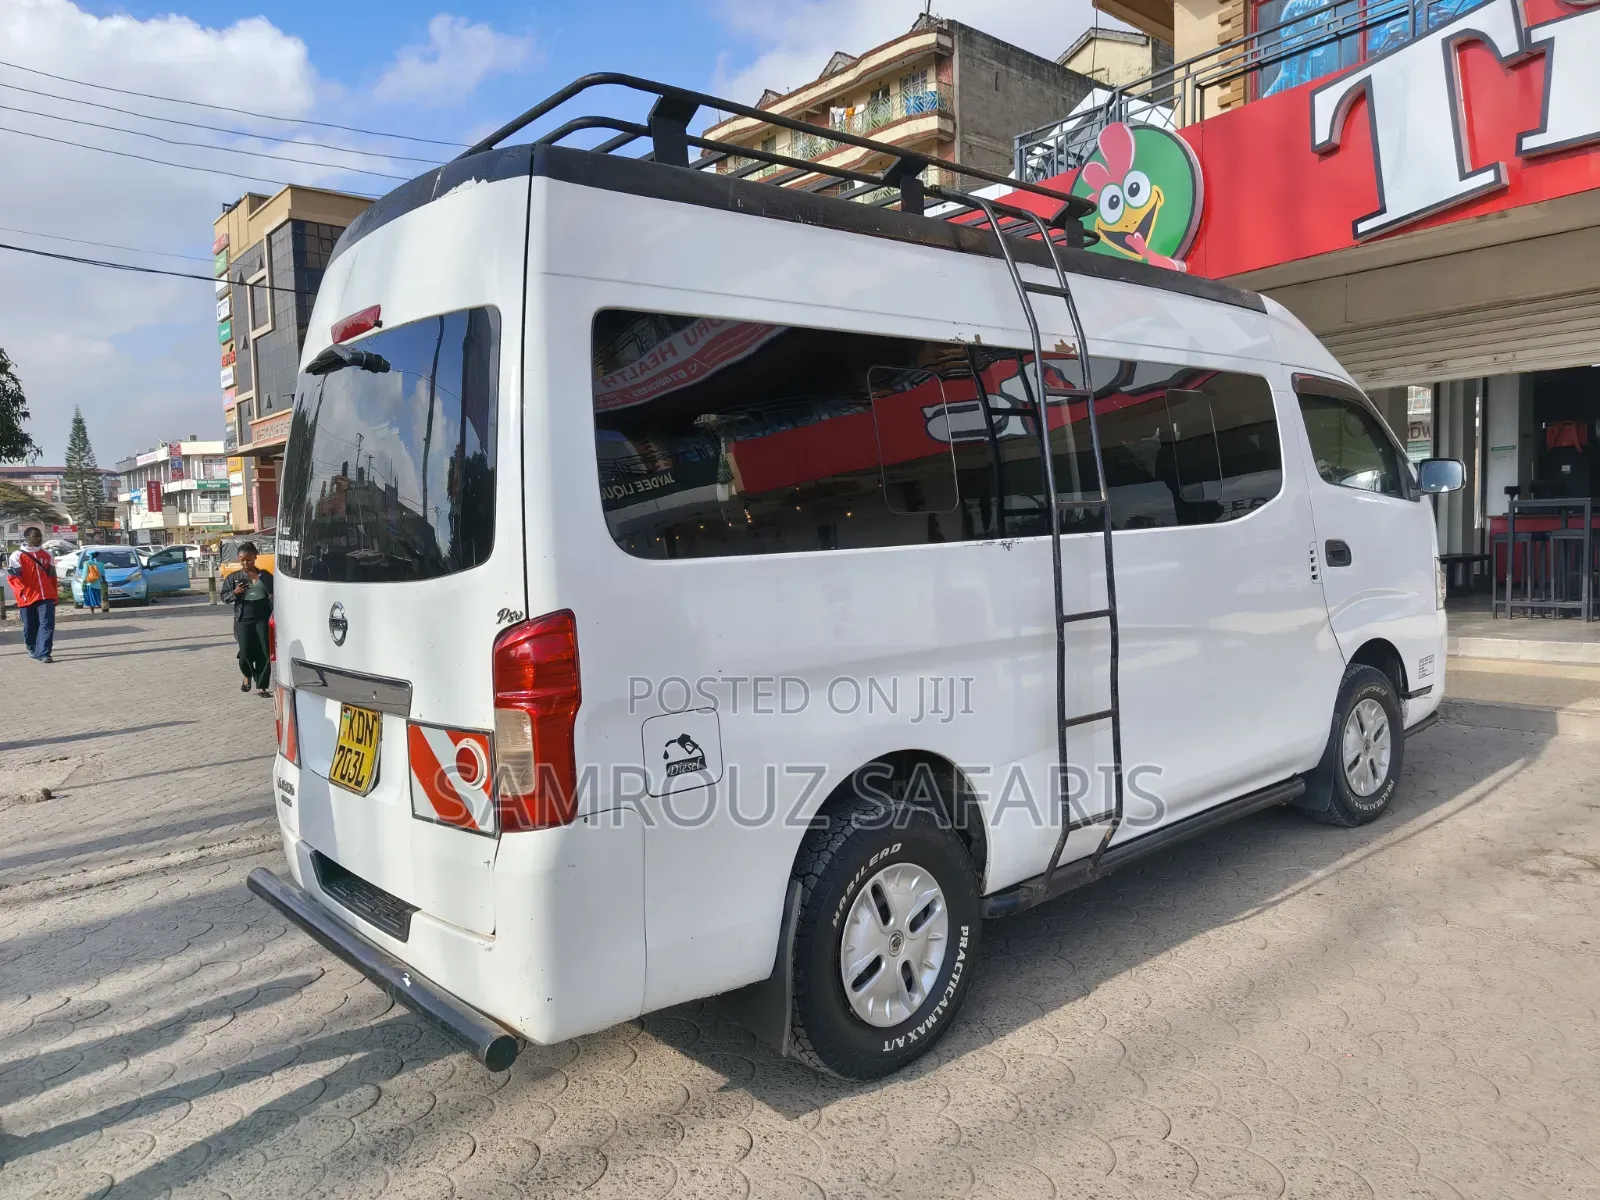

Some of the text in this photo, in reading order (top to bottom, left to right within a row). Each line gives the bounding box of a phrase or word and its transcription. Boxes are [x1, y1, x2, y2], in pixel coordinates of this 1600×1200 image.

[347, 710, 377, 748] KDN
[333, 745, 366, 788] 703L
[666, 759, 703, 777] Diesel
[831, 842, 903, 929] HABILEAD
[883, 925, 970, 1053] PRACTICALMAX A/T
